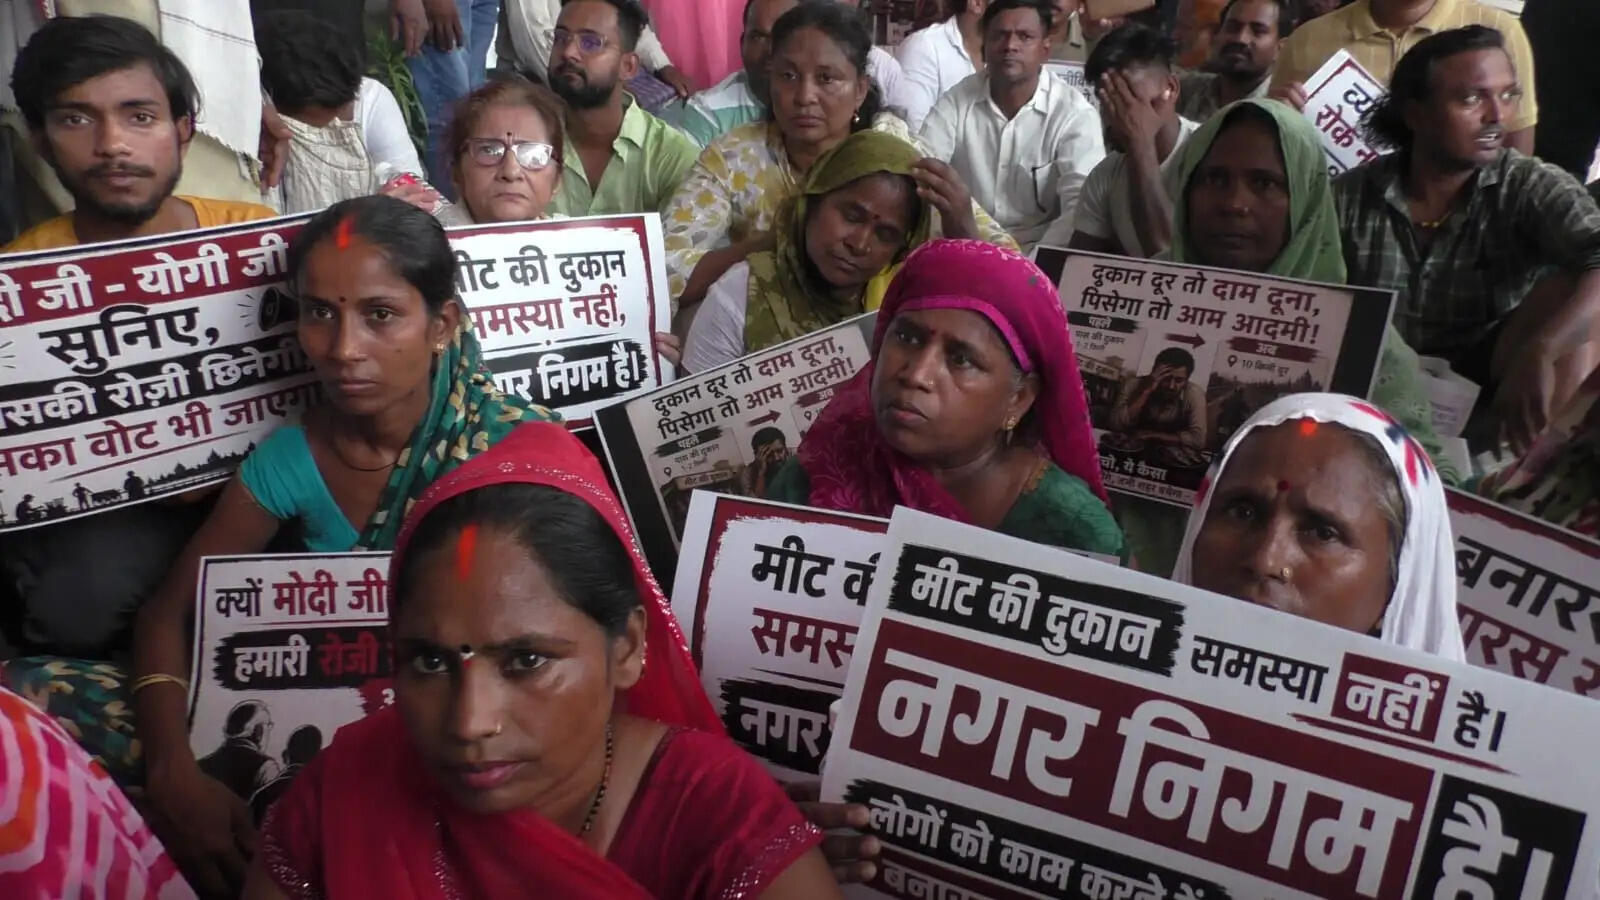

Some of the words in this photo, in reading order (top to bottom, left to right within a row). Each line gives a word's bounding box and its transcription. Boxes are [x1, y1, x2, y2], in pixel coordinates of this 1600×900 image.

[31, 263, 95, 311] जी
[132, 242, 230, 296] योगी
[237, 232, 289, 279] जी
[504, 245, 550, 286] की
[554, 250, 627, 293] दुकान
[1091, 264, 1146, 288] दुकान
[1152, 270, 1177, 295] दूर
[1182, 271, 1208, 295] तो
[1212, 278, 1262, 304] दाम
[1267, 287, 1322, 316] दूना,
[569, 283, 627, 327] नहीं,
[1080, 286, 1144, 316] पिसेगा
[1149, 297, 1174, 321] तो
[1177, 304, 1226, 330] आम
[1231, 312, 1321, 344] आदमी!
[38, 303, 220, 376] सुनिए,
[493, 369, 534, 402] गर
[537, 353, 611, 400] निगम
[611, 341, 640, 389] है।
[0, 381, 98, 430] सकी
[104, 363, 190, 410] रोज़ी
[653, 384, 702, 418] दुकान
[705, 374, 732, 399] दूर
[732, 363, 753, 386] तो
[755, 350, 796, 378] दाम
[797, 336, 845, 367] दूना,
[656, 405, 718, 440] पिसेगा
[720, 395, 742, 420] तो
[745, 381, 785, 411] आम
[788, 356, 857, 394] आदमी!
[85, 419, 160, 458] वोट
[168, 400, 214, 438] भी
[215, 577, 264, 617] क्यों
[272, 569, 338, 616] मोदी
[347, 568, 388, 613] जी
[751, 535, 835, 598] मीट
[844, 552, 881, 606] क
[233, 634, 311, 682] हमारी
[911, 557, 983, 616] मीट
[988, 573, 1041, 632] की
[1041, 594, 1162, 660] दुकान
[1190, 635, 1330, 703] समस्या
[1344, 672, 1442, 733] नहीं
[1453, 690, 1508, 752] है।
[739, 697, 828, 758] नगर
[876, 648, 1102, 798] नगर
[1107, 699, 1415, 898] निगम
[869, 795, 948, 849] लोगों
[950, 819, 994, 865] को
[1000, 837, 1076, 891] काम
